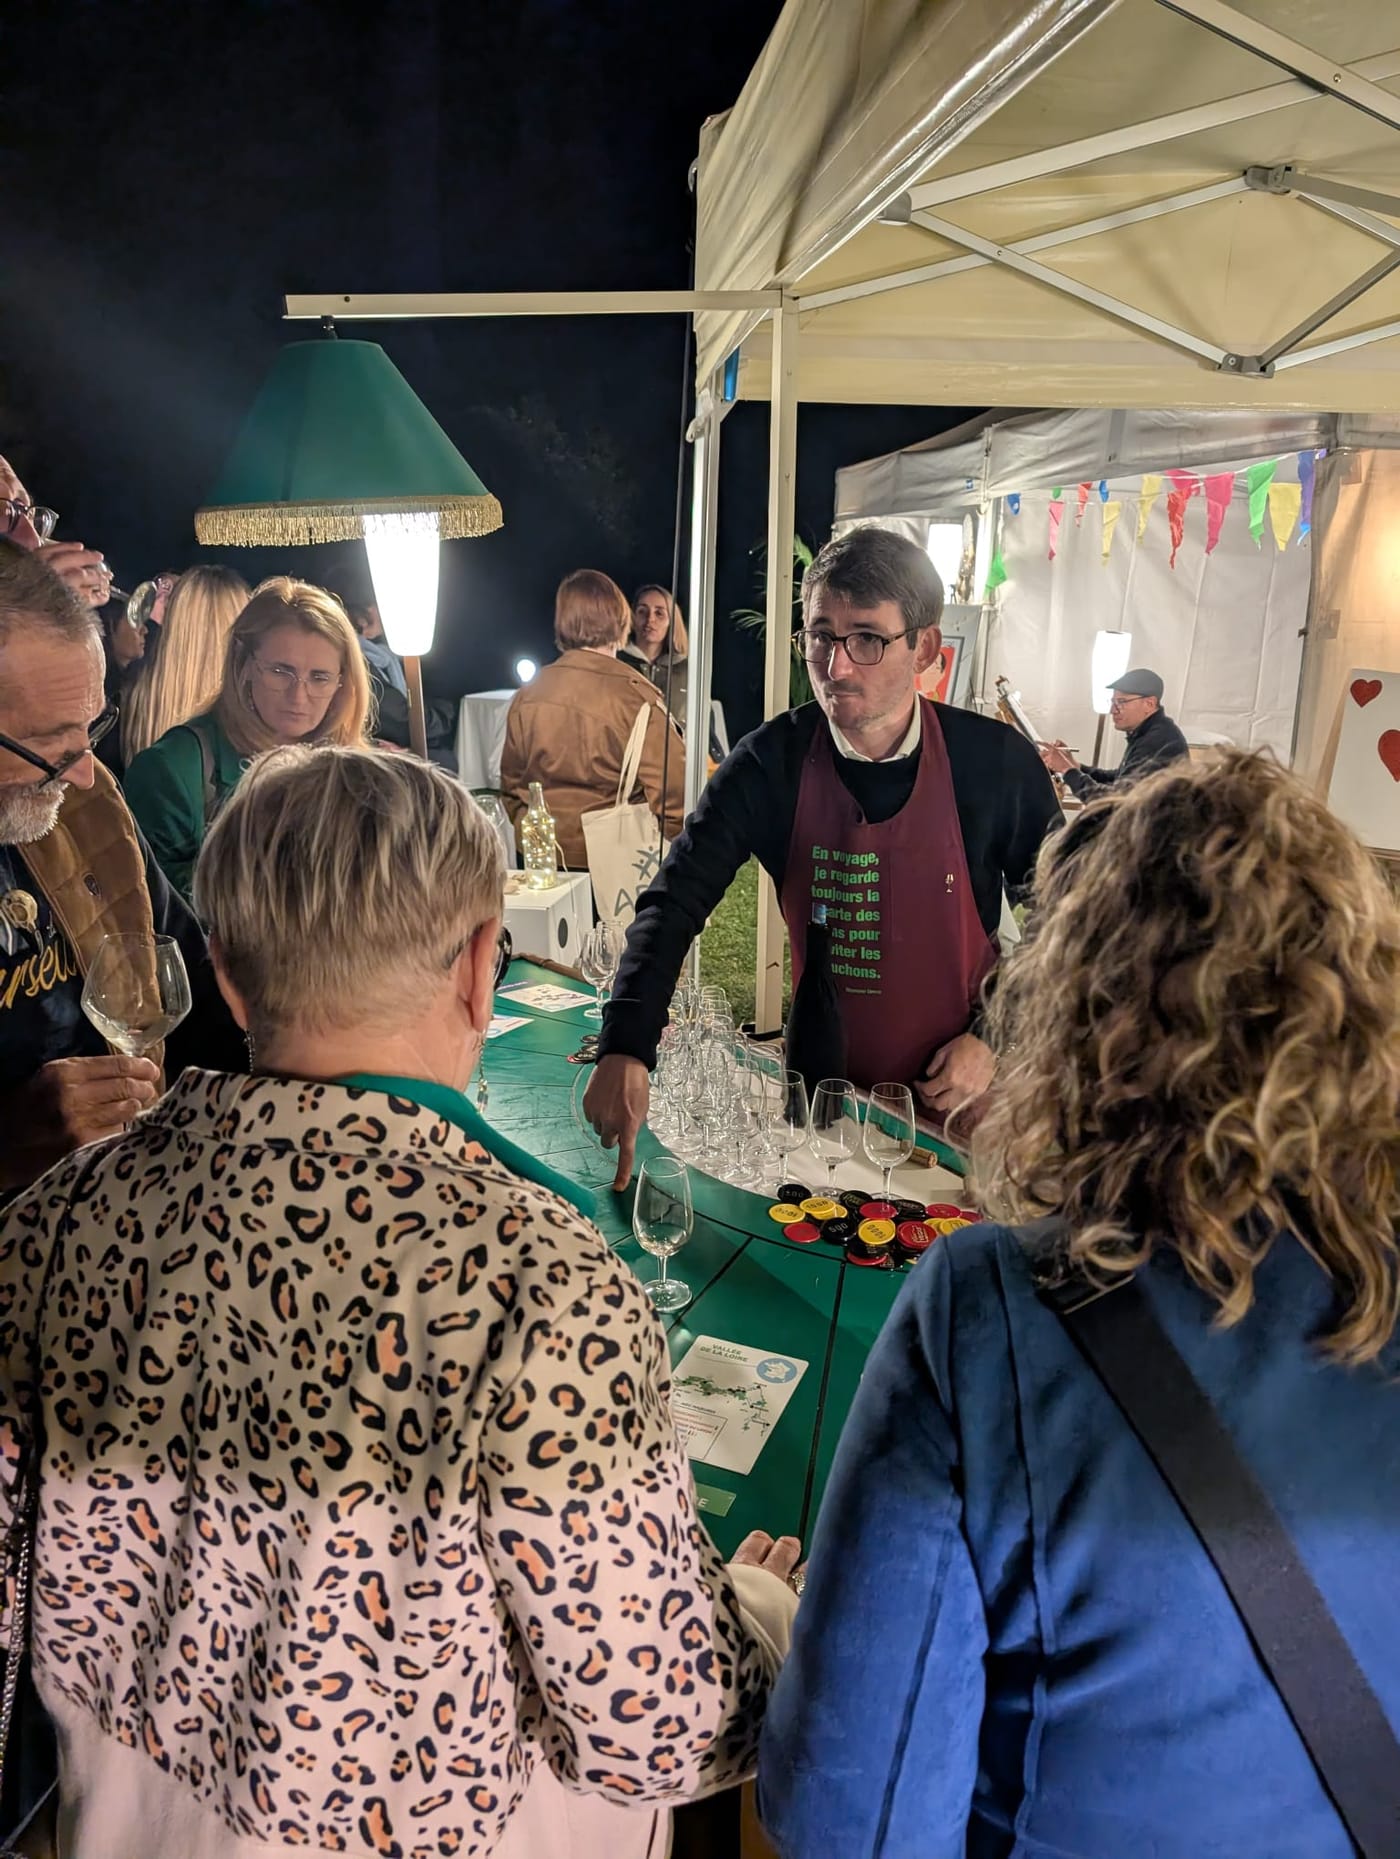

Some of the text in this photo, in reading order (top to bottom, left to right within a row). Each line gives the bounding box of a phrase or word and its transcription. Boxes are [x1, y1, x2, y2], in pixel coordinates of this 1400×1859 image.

[812, 845, 880, 868] En voyage,
[814, 865, 880, 886] je regarde
[811, 885, 880, 903] toujours la
[825, 907, 881, 922] arte des
[849, 930, 881, 943] pour
[860, 946, 881, 960] les
[831, 963, 881, 979] uchons.
[828, 1222, 849, 1234] 500
[724, 1352, 749, 1362] LOIRE
